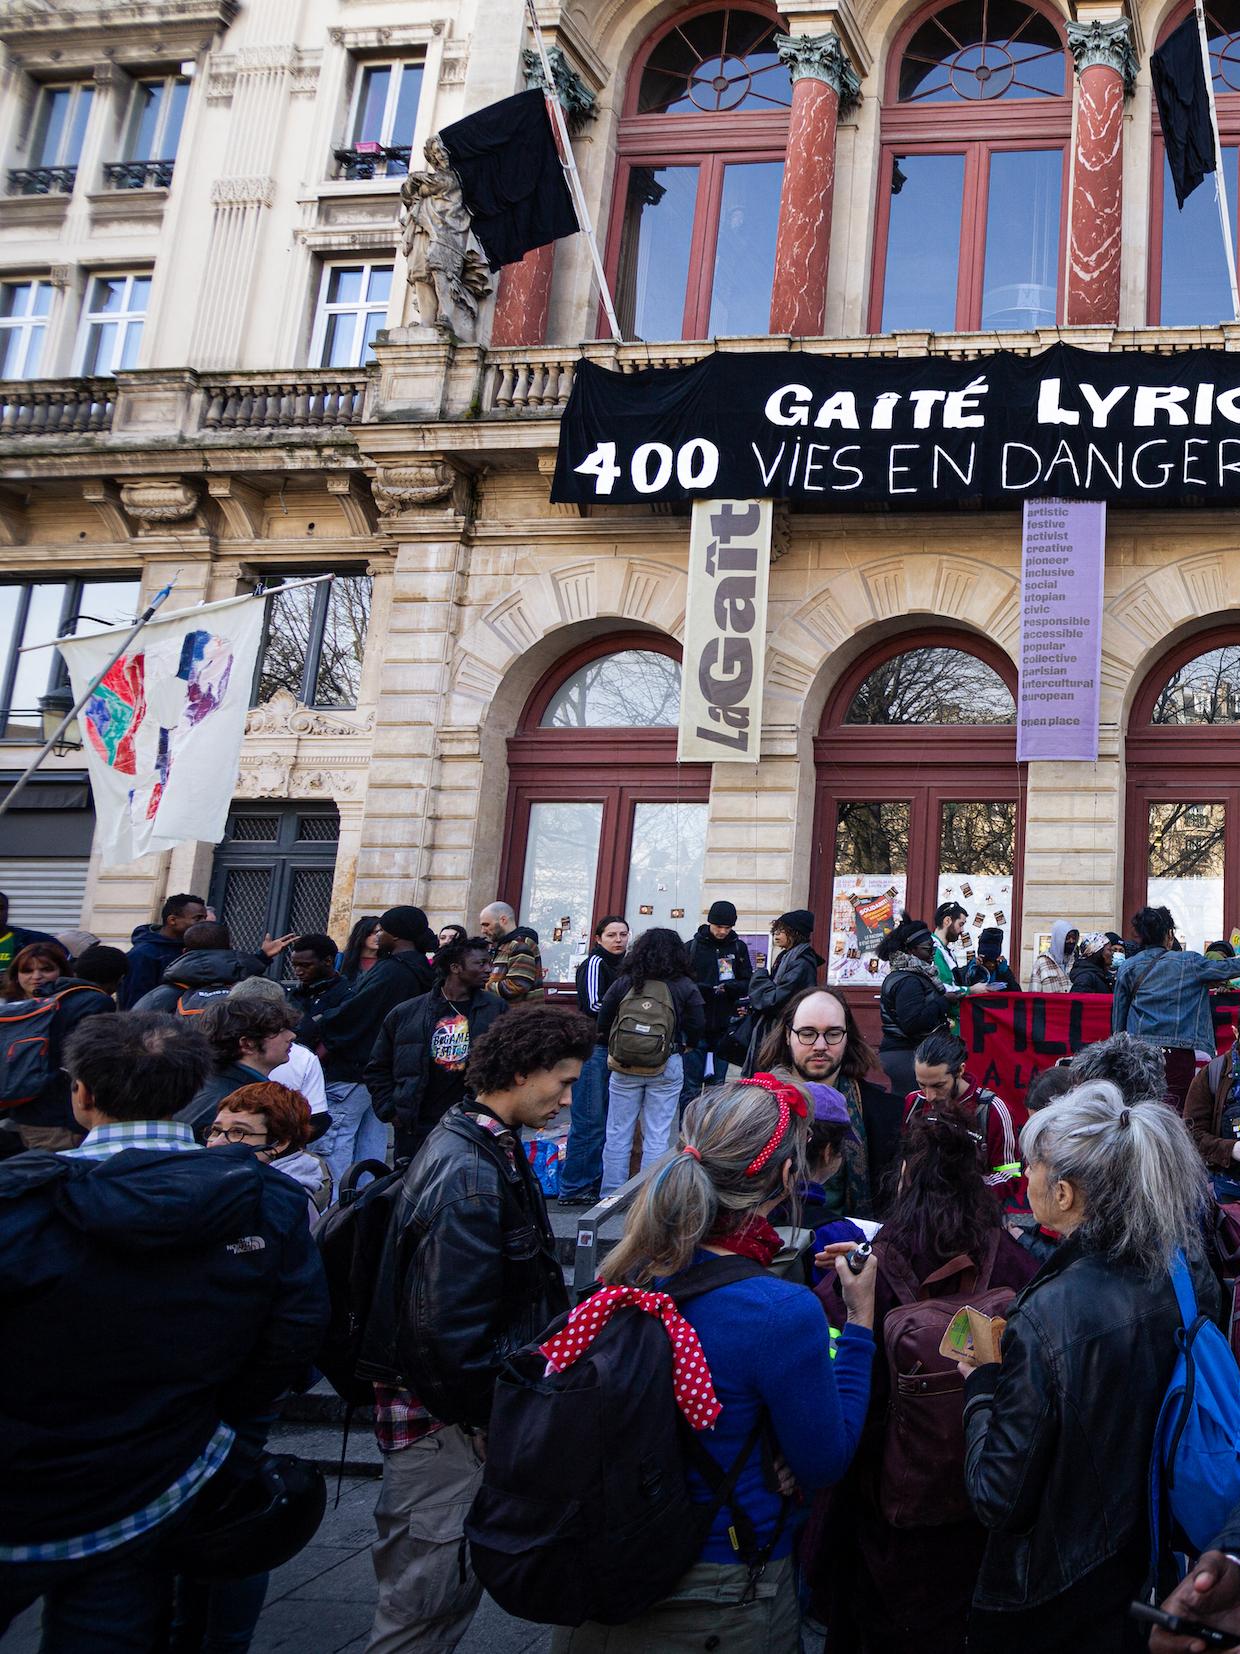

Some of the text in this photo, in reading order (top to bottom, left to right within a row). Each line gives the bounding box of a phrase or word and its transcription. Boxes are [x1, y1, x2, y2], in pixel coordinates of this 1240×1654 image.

[573, 437, 720, 495] 400
[888, 441, 976, 495] EN
[1027, 507, 1069, 517] artistic
[1027, 519, 1065, 529] festive
[1027, 531, 1068, 541] activist
[1026, 544, 1073, 554] creative
[1025, 556, 1069, 568] pioneer
[1025, 568, 1075, 578] inclusive
[1025, 580, 1058, 590] social
[1024, 592, 1066, 603] utopian
[1024, 604, 1050, 615] civic
[1023, 617, 1090, 628] responsible
[1023, 629, 1083, 639] accessible
[1023, 642, 1066, 654] popular
[1022, 654, 1077, 664] collective
[1022, 666, 1067, 678] parisian
[1022, 679, 1094, 689] intercultural
[1022, 691, 1074, 702] european
[1021, 716, 1080, 728] open place
